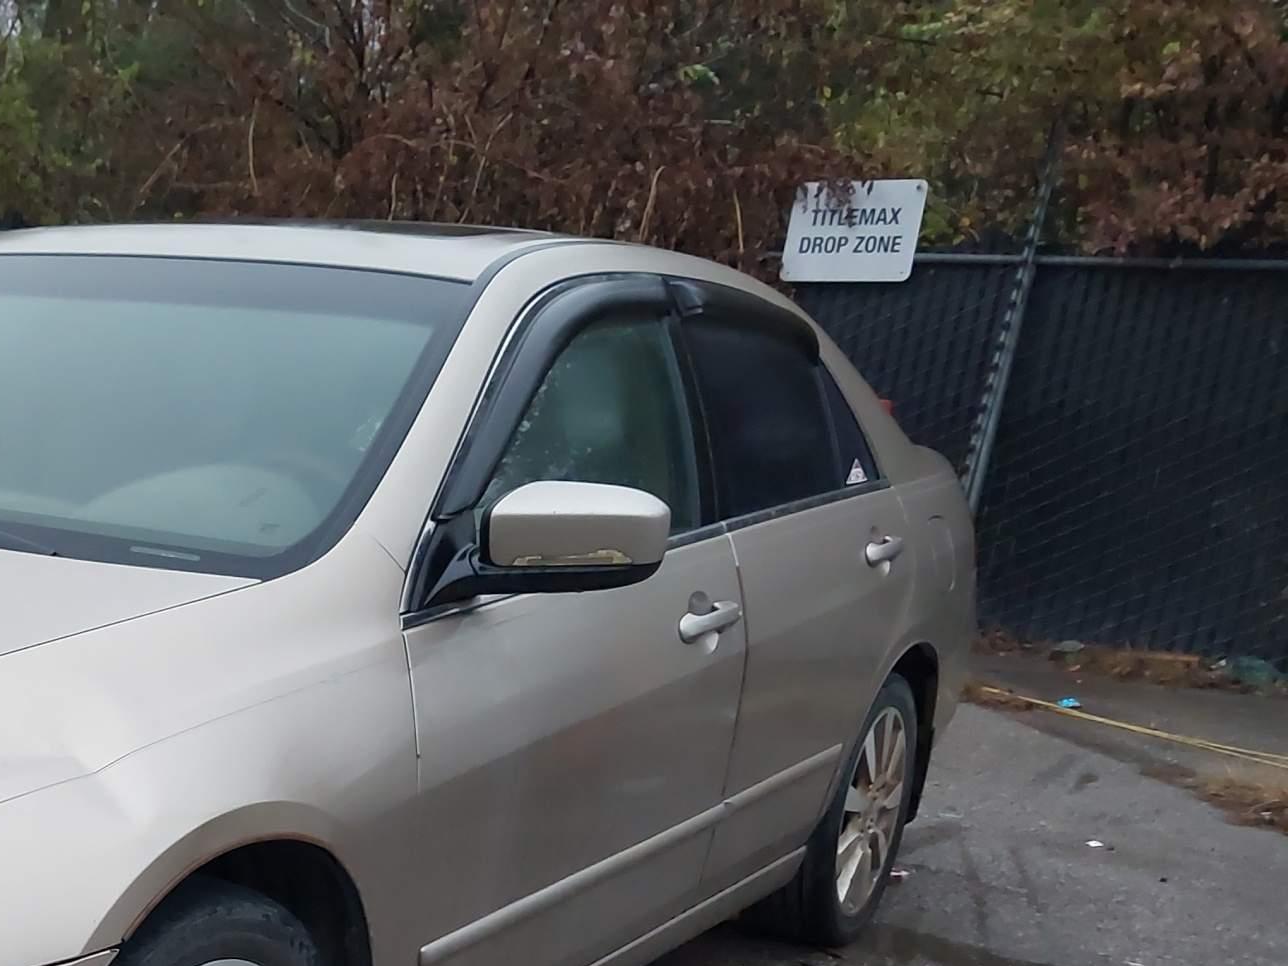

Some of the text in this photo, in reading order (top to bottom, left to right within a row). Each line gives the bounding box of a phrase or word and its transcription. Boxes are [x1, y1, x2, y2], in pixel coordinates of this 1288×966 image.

[812, 207, 902, 226] TITLEMAX
[798, 235, 903, 254] DROP ZONE
